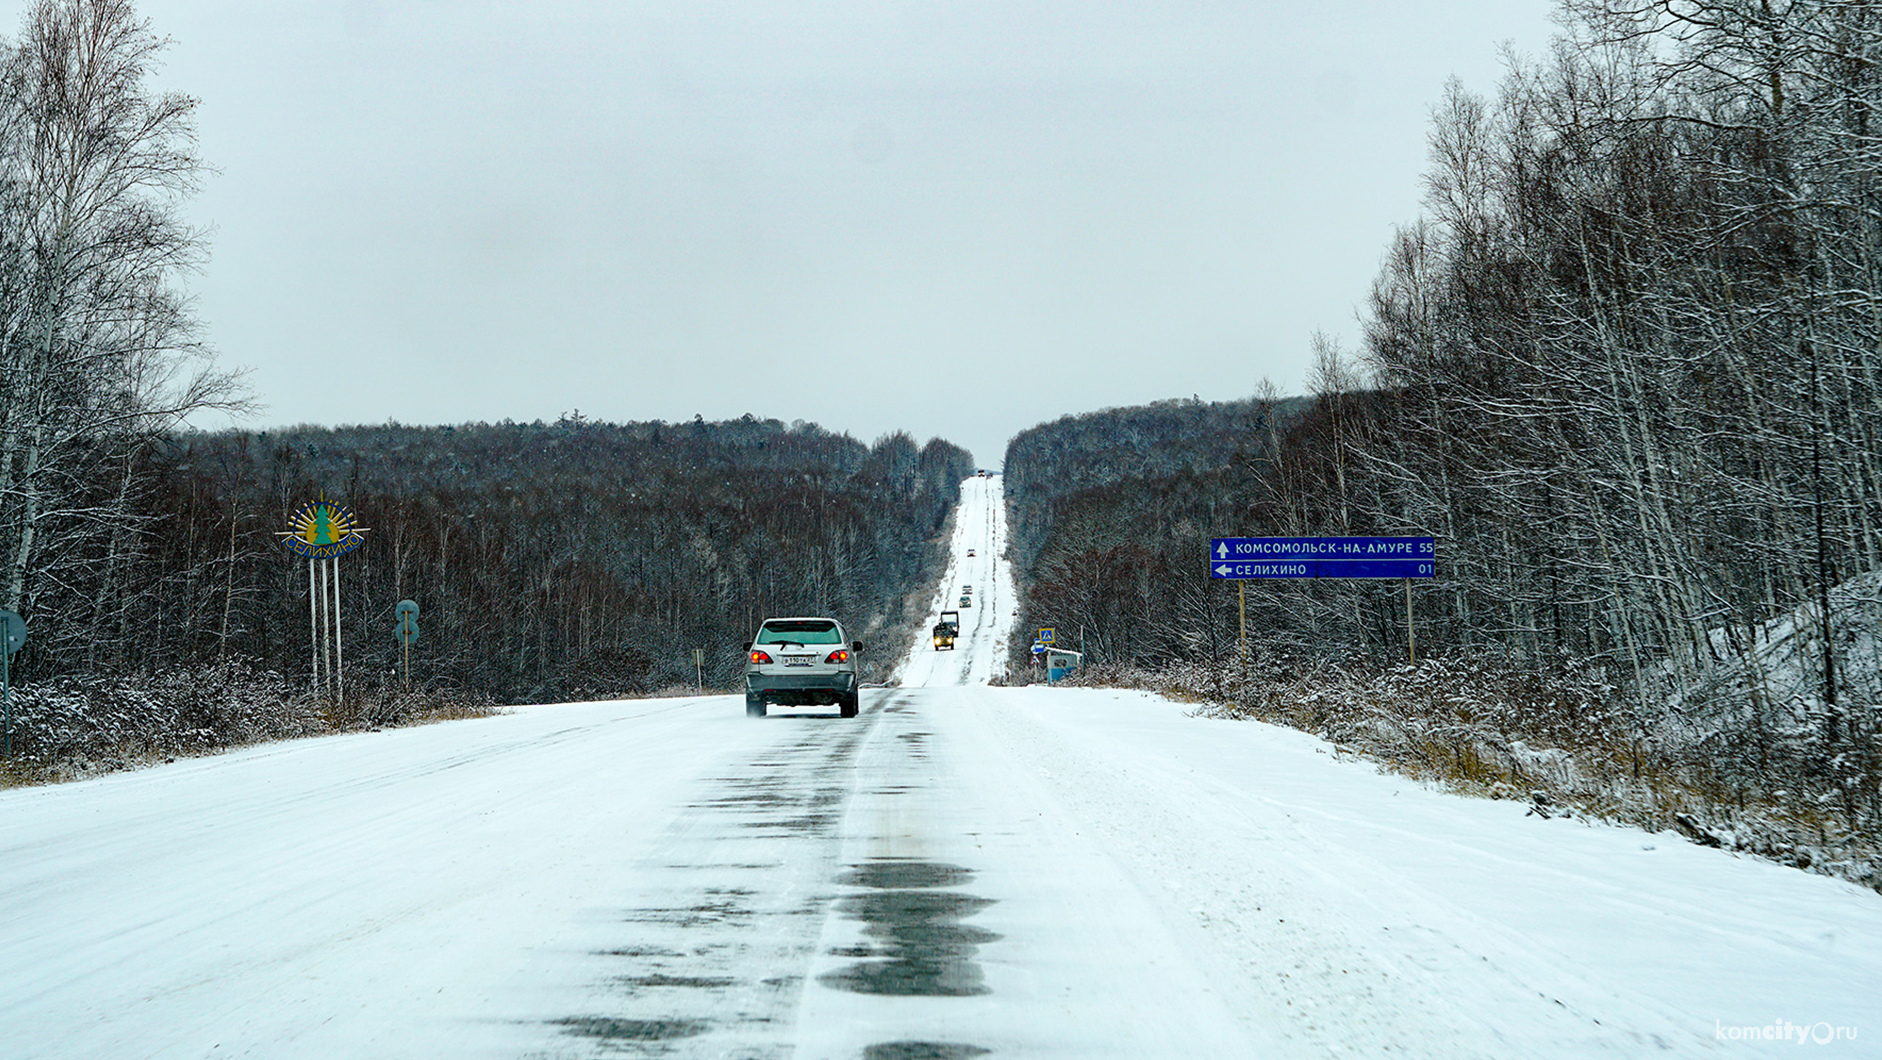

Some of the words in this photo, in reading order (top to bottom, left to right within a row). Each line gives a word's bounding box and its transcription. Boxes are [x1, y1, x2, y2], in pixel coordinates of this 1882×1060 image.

[285, 534, 360, 558] СЕЛИХИНО
[1235, 543, 1413, 554] КОМСОМОЛЬСК-НА-АМУРЕ
[1419, 543, 1434, 553] 55
[1235, 564, 1307, 575] СЕЛИХИНО
[1418, 564, 1433, 574] 01
